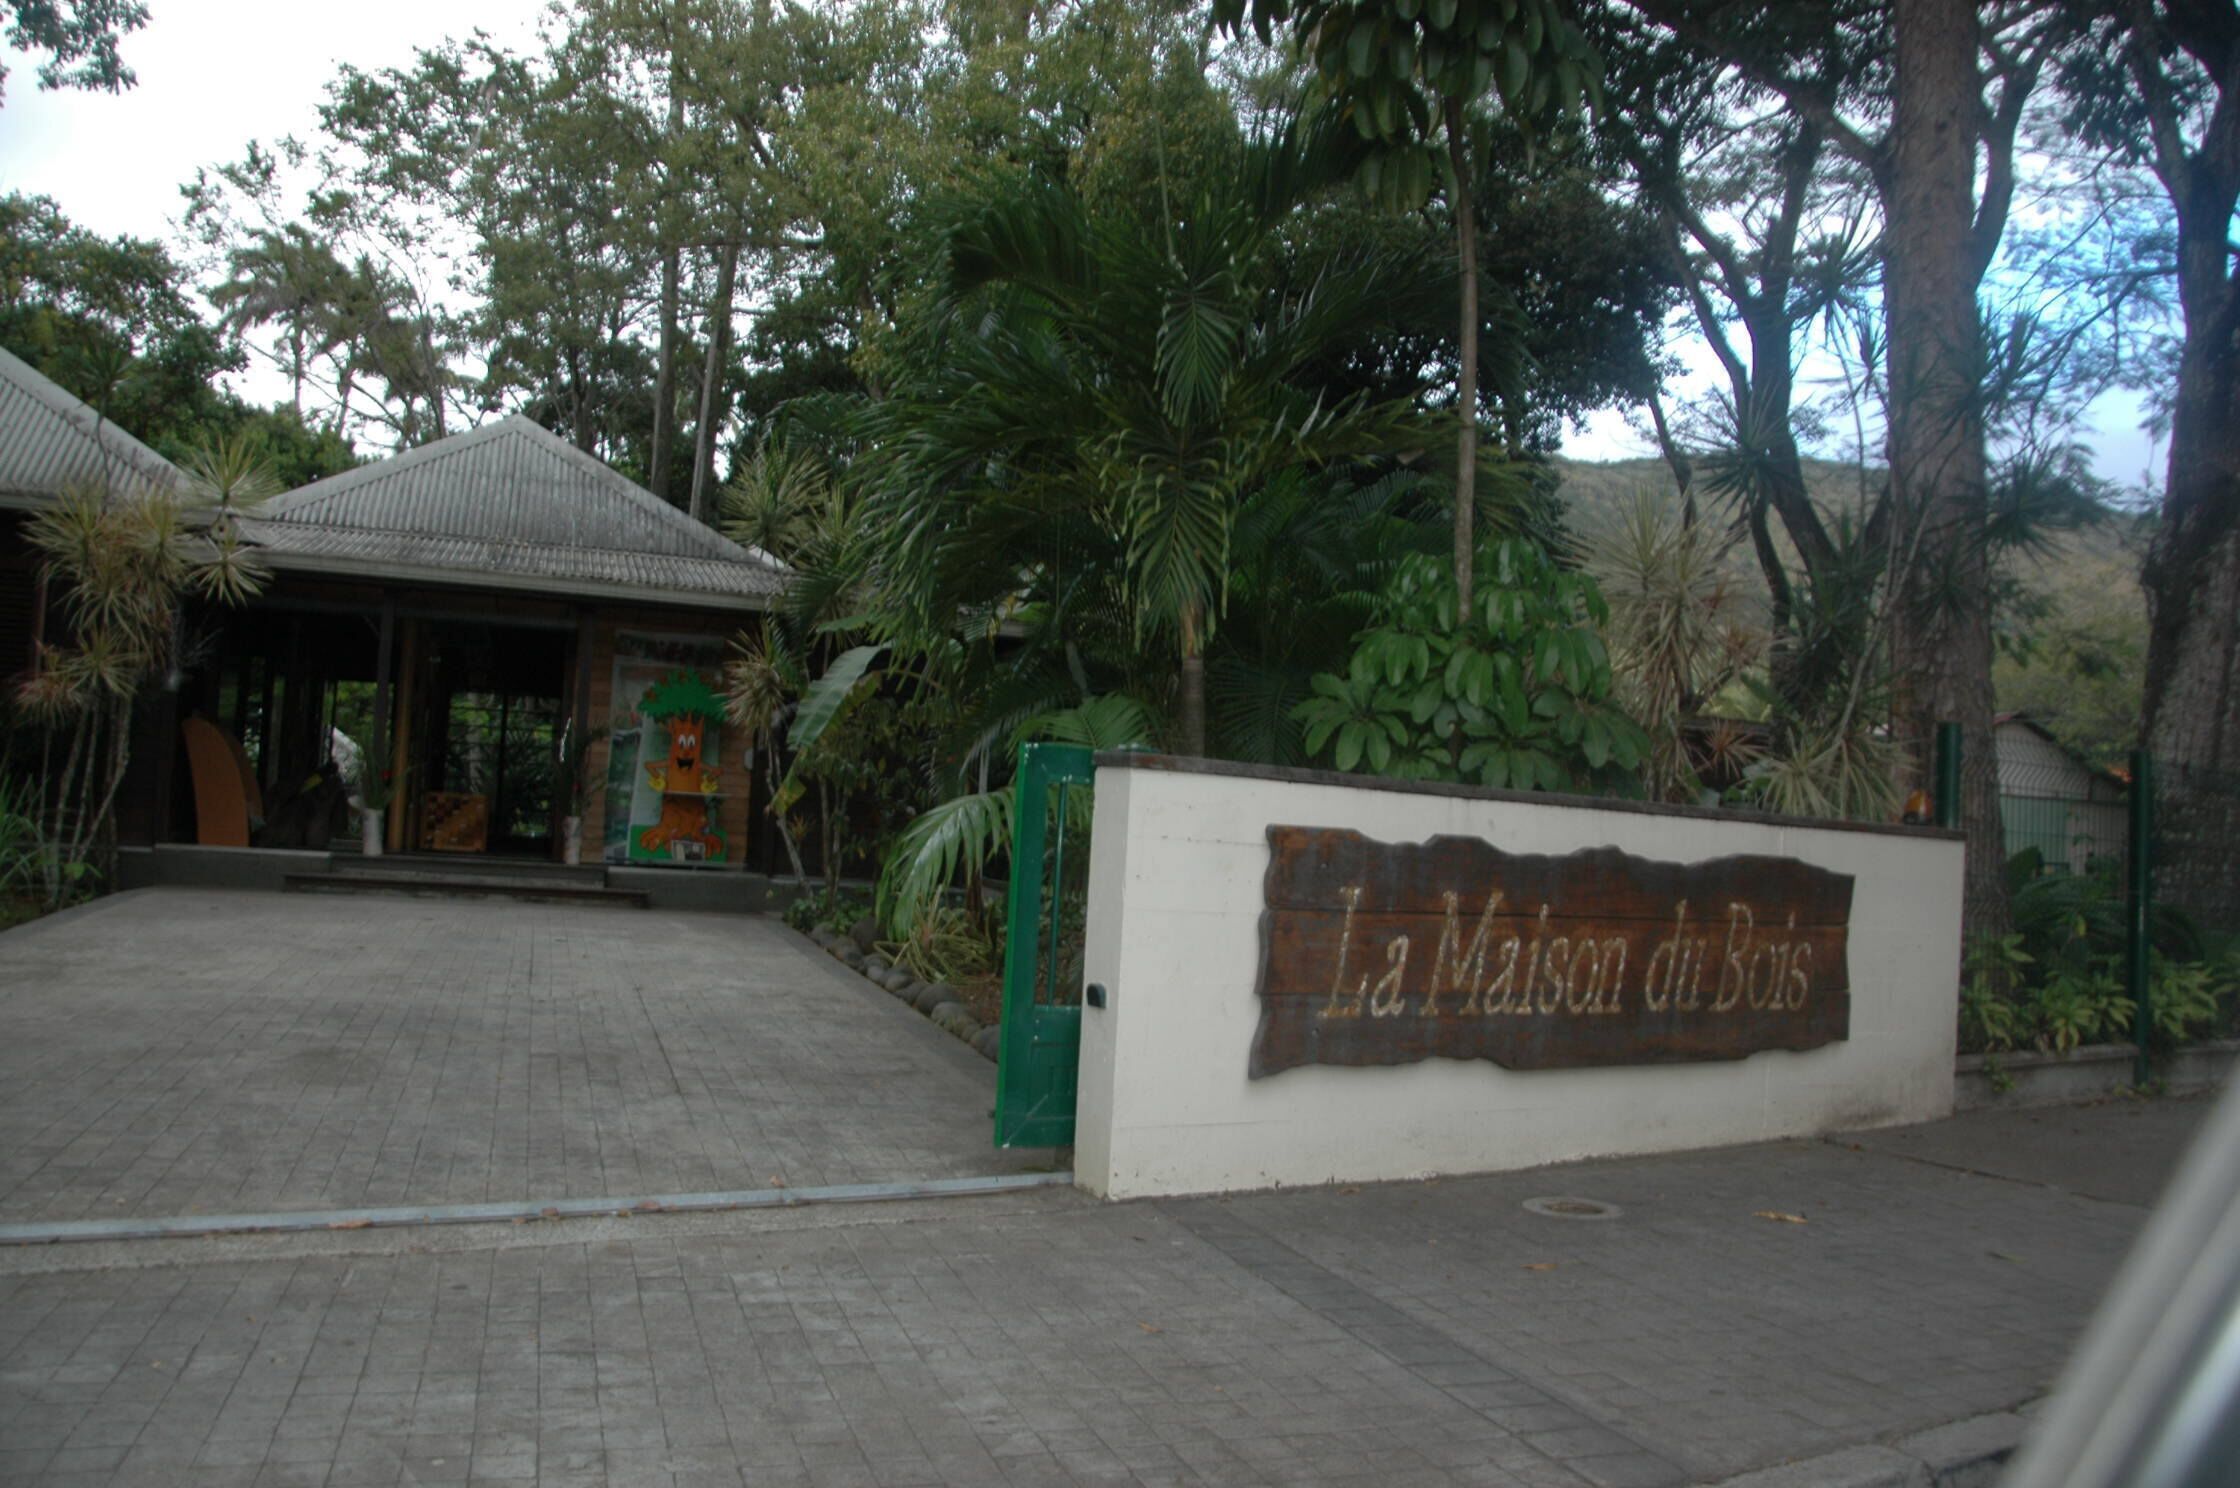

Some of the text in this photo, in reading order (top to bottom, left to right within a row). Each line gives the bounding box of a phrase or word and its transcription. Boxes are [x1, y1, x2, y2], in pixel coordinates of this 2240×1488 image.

[1317, 885, 1812, 1018] La Maison du Bois
